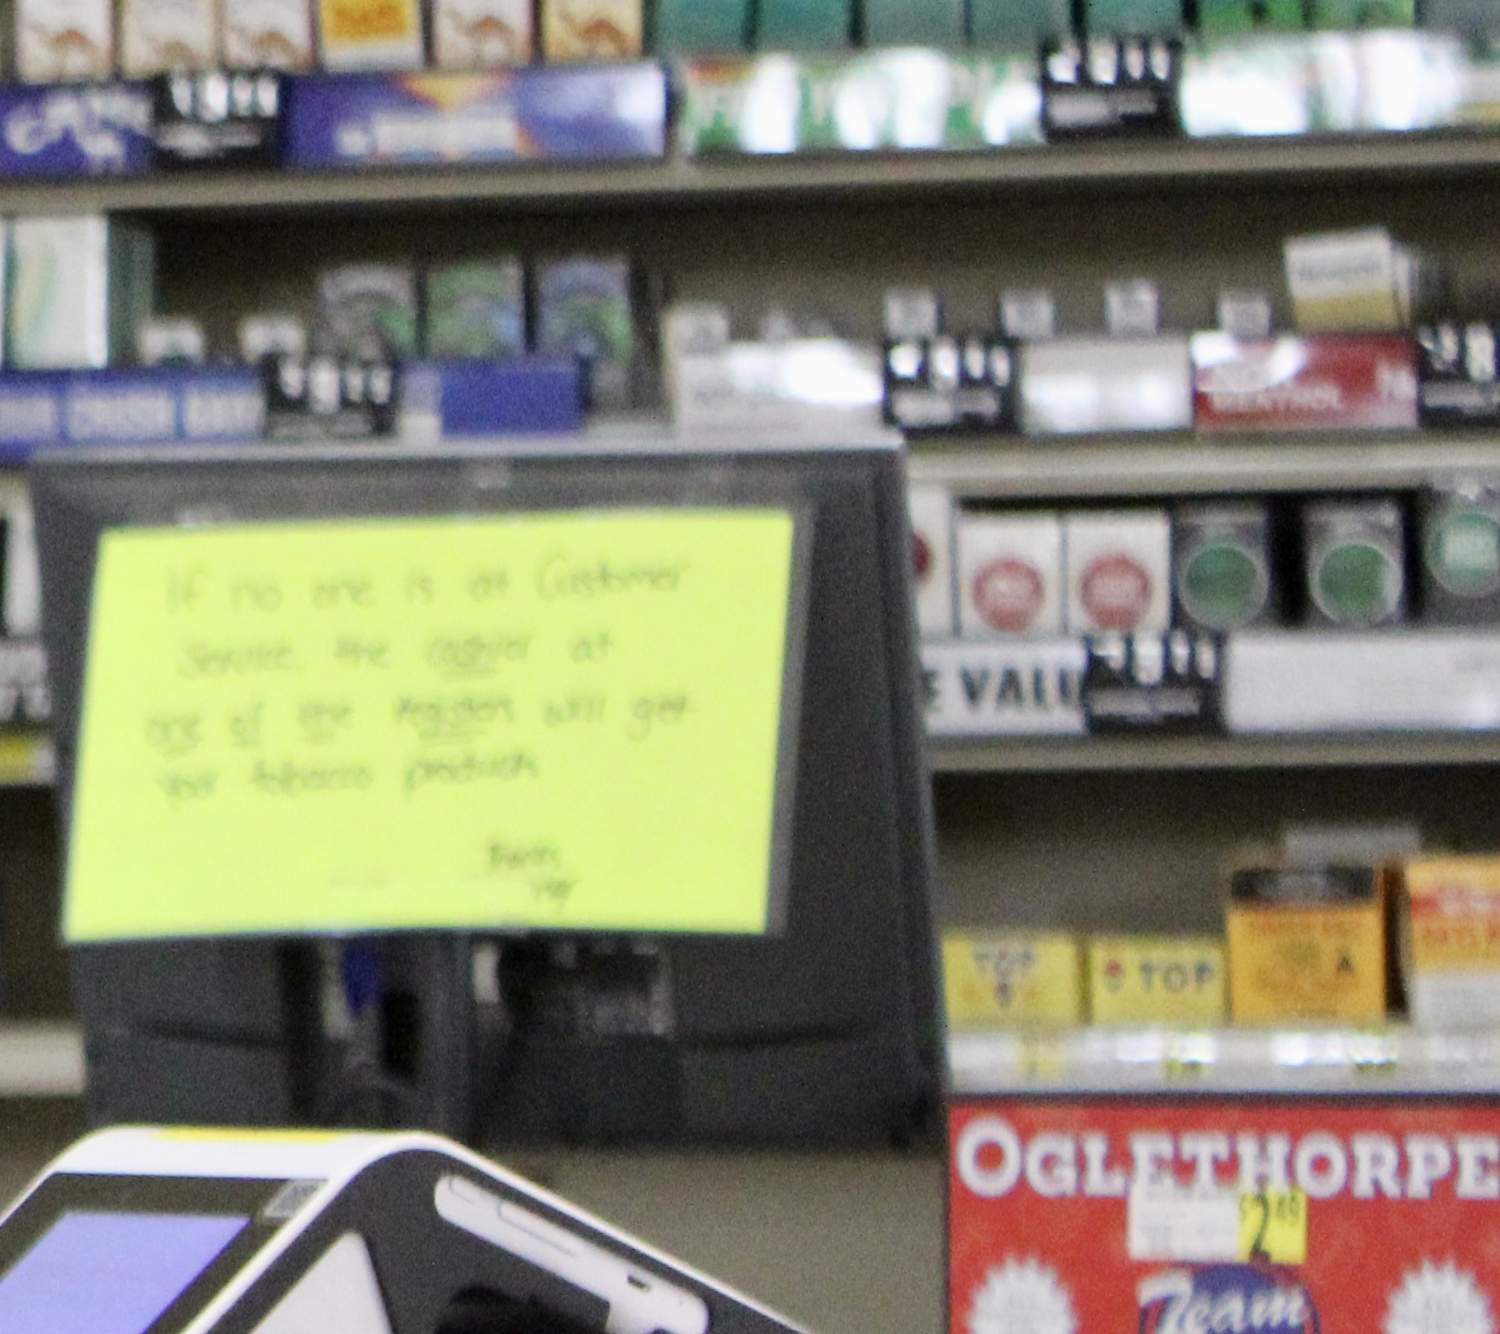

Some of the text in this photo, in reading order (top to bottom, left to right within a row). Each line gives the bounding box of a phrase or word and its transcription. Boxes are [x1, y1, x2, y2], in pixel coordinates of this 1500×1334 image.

[166, 547, 693, 613] If no one is at Customer
[333, 632, 394, 671] the
[569, 631, 618, 663] at
[227, 699, 268, 741] of
[541, 690, 607, 727] will
[630, 687, 694, 741] get
[250, 754, 375, 796] tobacco
[1138, 959, 1216, 995] TOP
[955, 1112, 1500, 1202] OGLETHORPE
